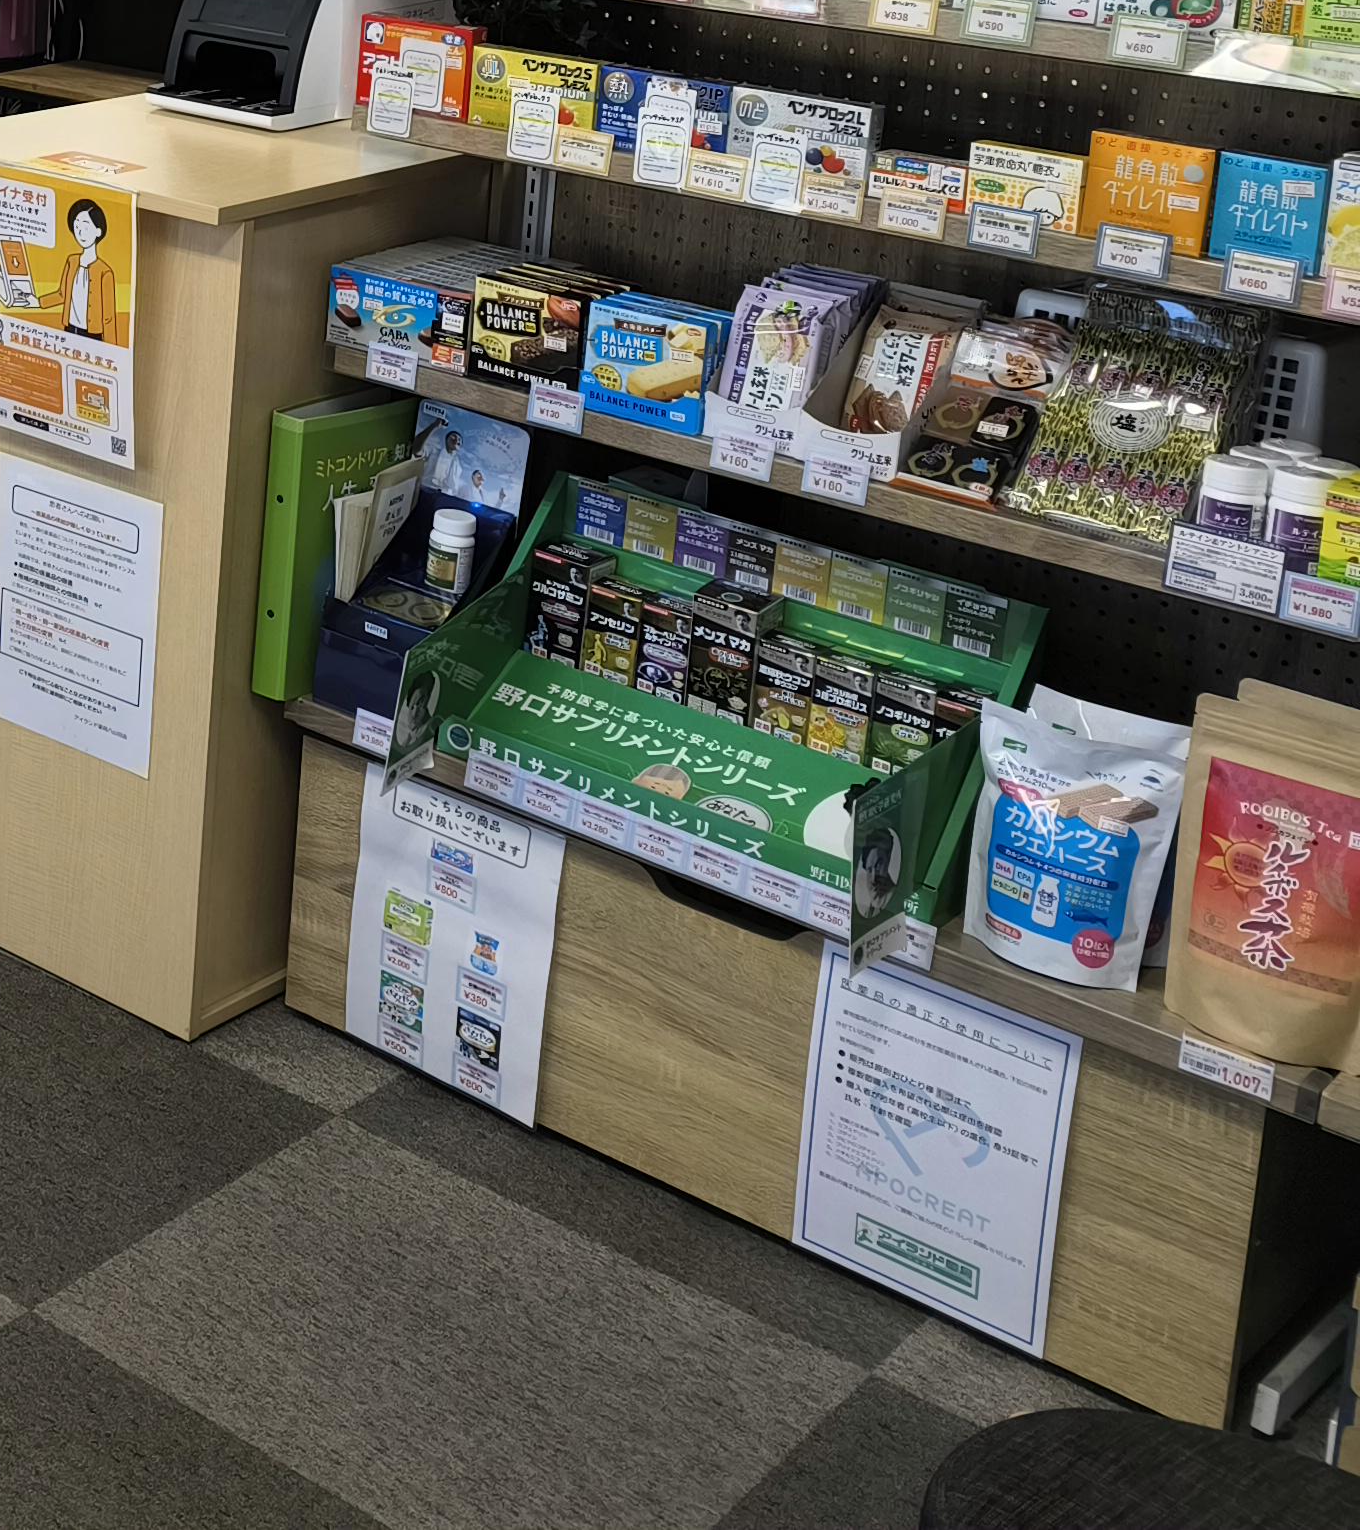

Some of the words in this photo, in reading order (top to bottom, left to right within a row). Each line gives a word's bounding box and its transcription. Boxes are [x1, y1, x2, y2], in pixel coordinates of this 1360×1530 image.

[976, 19, 1004, 33] ¥590
[520, 56, 594, 82] ベンザブロックS
[559, 76, 592, 92] プレミアム
[736, 99, 768, 122] のど
[786, 98, 867, 127] ベンザブロックL
[1113, 152, 1180, 187] 龍角散
[692, 175, 725, 189] ¥1,610
[807, 196, 840, 211] ¥1,540
[1238, 177, 1300, 212] 龍角散
[886, 214, 920, 230] ¥1,000
[1227, 202, 1310, 236] ダイレクト
[976, 230, 1011, 246] ¥1,230
[1109, 250, 1139, 267] ¥700
[1238, 276, 1269, 292] ¥660
[485, 301, 537, 323] BALANCE
[378, 327, 410, 343] GABA
[485, 317, 525, 333] POWER
[600, 330, 657, 351] BALANCE
[600, 344, 644, 362] POWER
[588, 390, 631, 410] BALANCE
[632, 403, 668, 419] POWER
[720, 453, 749, 470] ¥160
[1214, 512, 1249, 526] ルテイン
[531, 580, 585, 606] グルコサミン
[589, 610, 636, 634] アンセリン
[1293, 601, 1333, 620] ¥1,980
[692, 625, 753, 654] メンズマカ
[547, 681, 772, 772] 予防医学に基づいた安心と信頼
[875, 703, 931, 730] ノコギリヤシ
[492, 681, 808, 808] 野口サプリメントシリーズ
[478, 737, 765, 859] 野口サプリメントシリーズ
[429, 794, 501, 834] こちらの商品
[400, 799, 521, 858] お取り扱いございます
[1009, 830, 1108, 876] ウエハース
[1236, 840, 1311, 972] ルイボス茶
